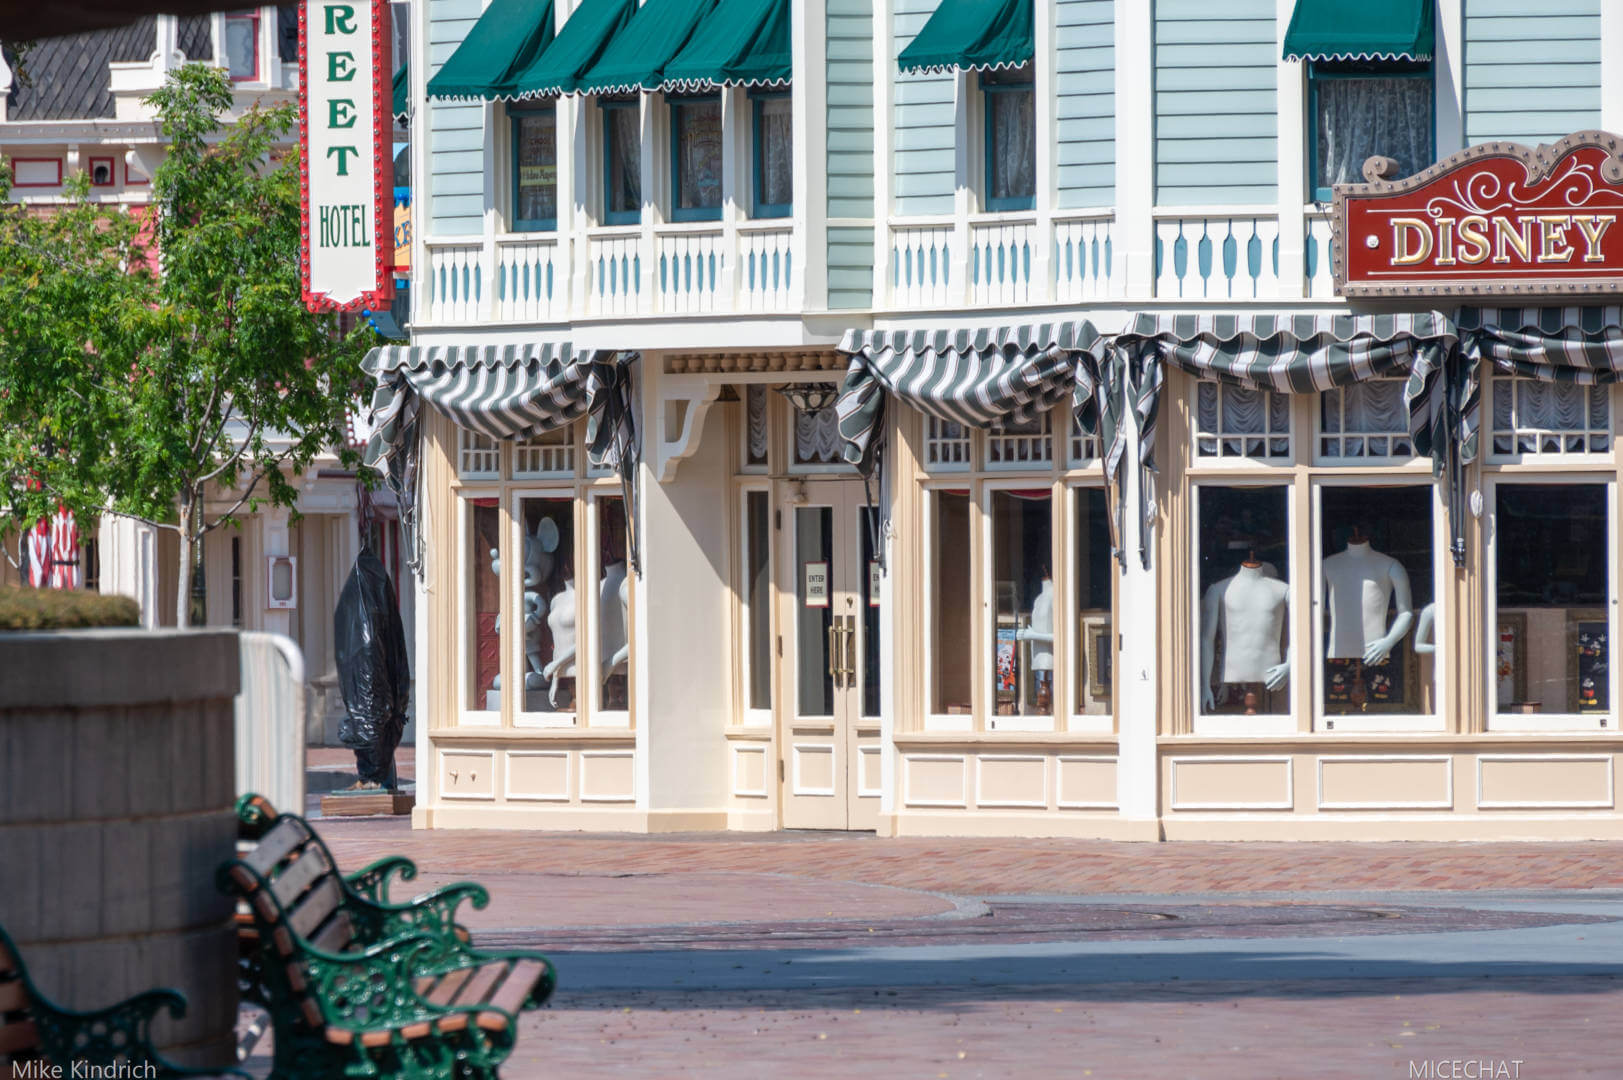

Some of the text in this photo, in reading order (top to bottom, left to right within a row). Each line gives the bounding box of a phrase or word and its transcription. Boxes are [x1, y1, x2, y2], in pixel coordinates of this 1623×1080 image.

[323, 4, 359, 176] REET
[319, 204, 371, 248] HOTEL
[1390, 215, 1617, 266] DISNEY
[808, 574, 825, 583] ENTER
[810, 586, 824, 594] HERE
